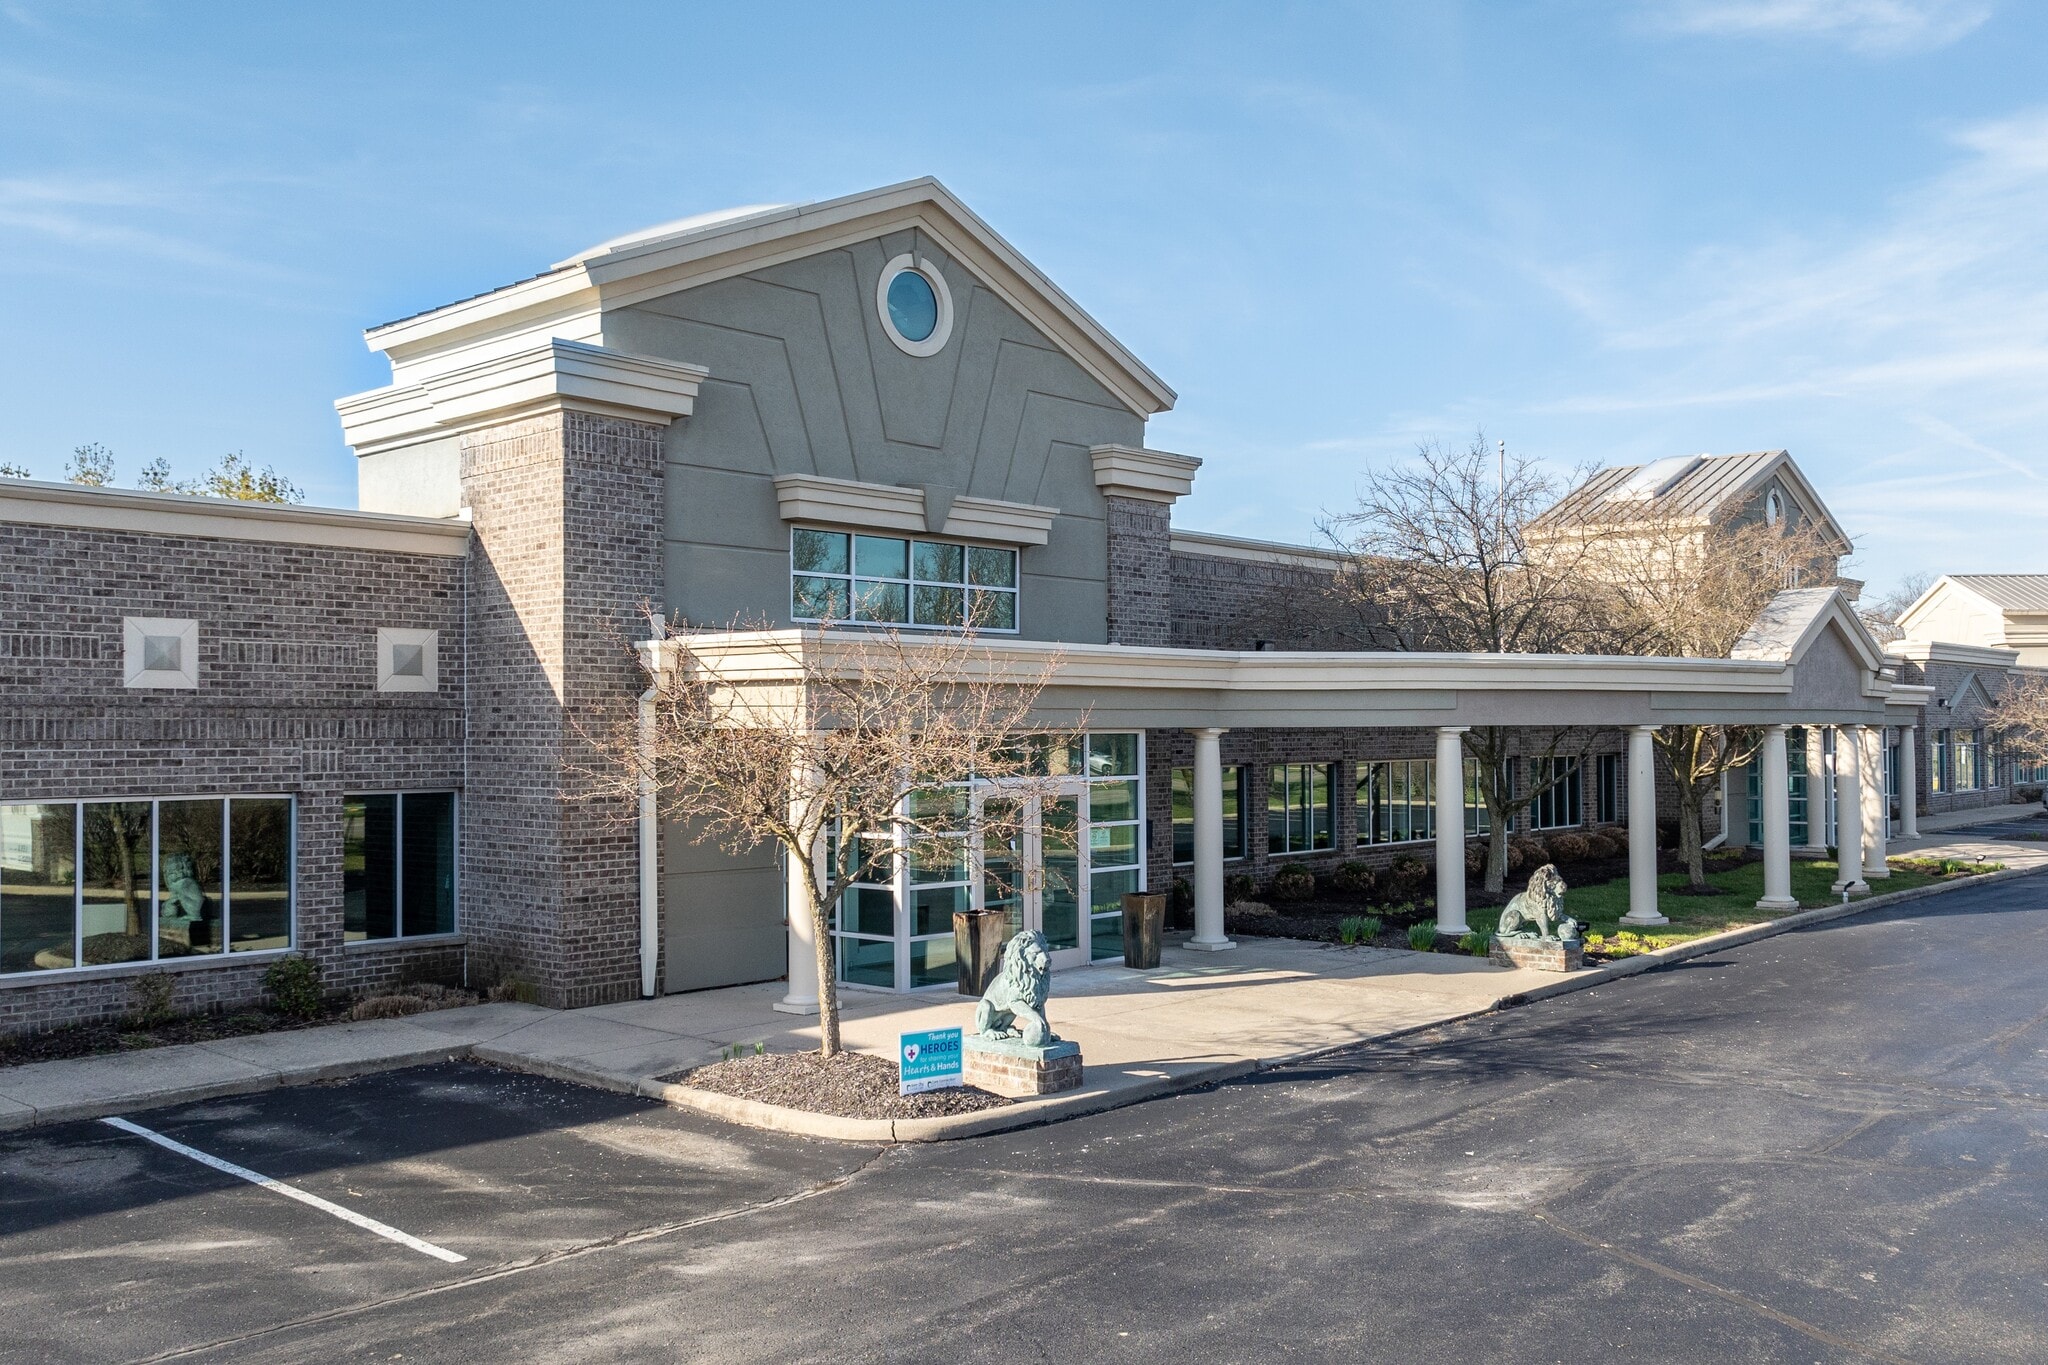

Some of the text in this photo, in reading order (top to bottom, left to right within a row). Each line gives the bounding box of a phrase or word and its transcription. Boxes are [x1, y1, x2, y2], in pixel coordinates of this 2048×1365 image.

[928, 1032, 959, 1040] Thank you
[921, 1041, 959, 1055] HEROES
[904, 1065, 930, 1075] Hearts
[937, 1061, 959, 1070] Hands
